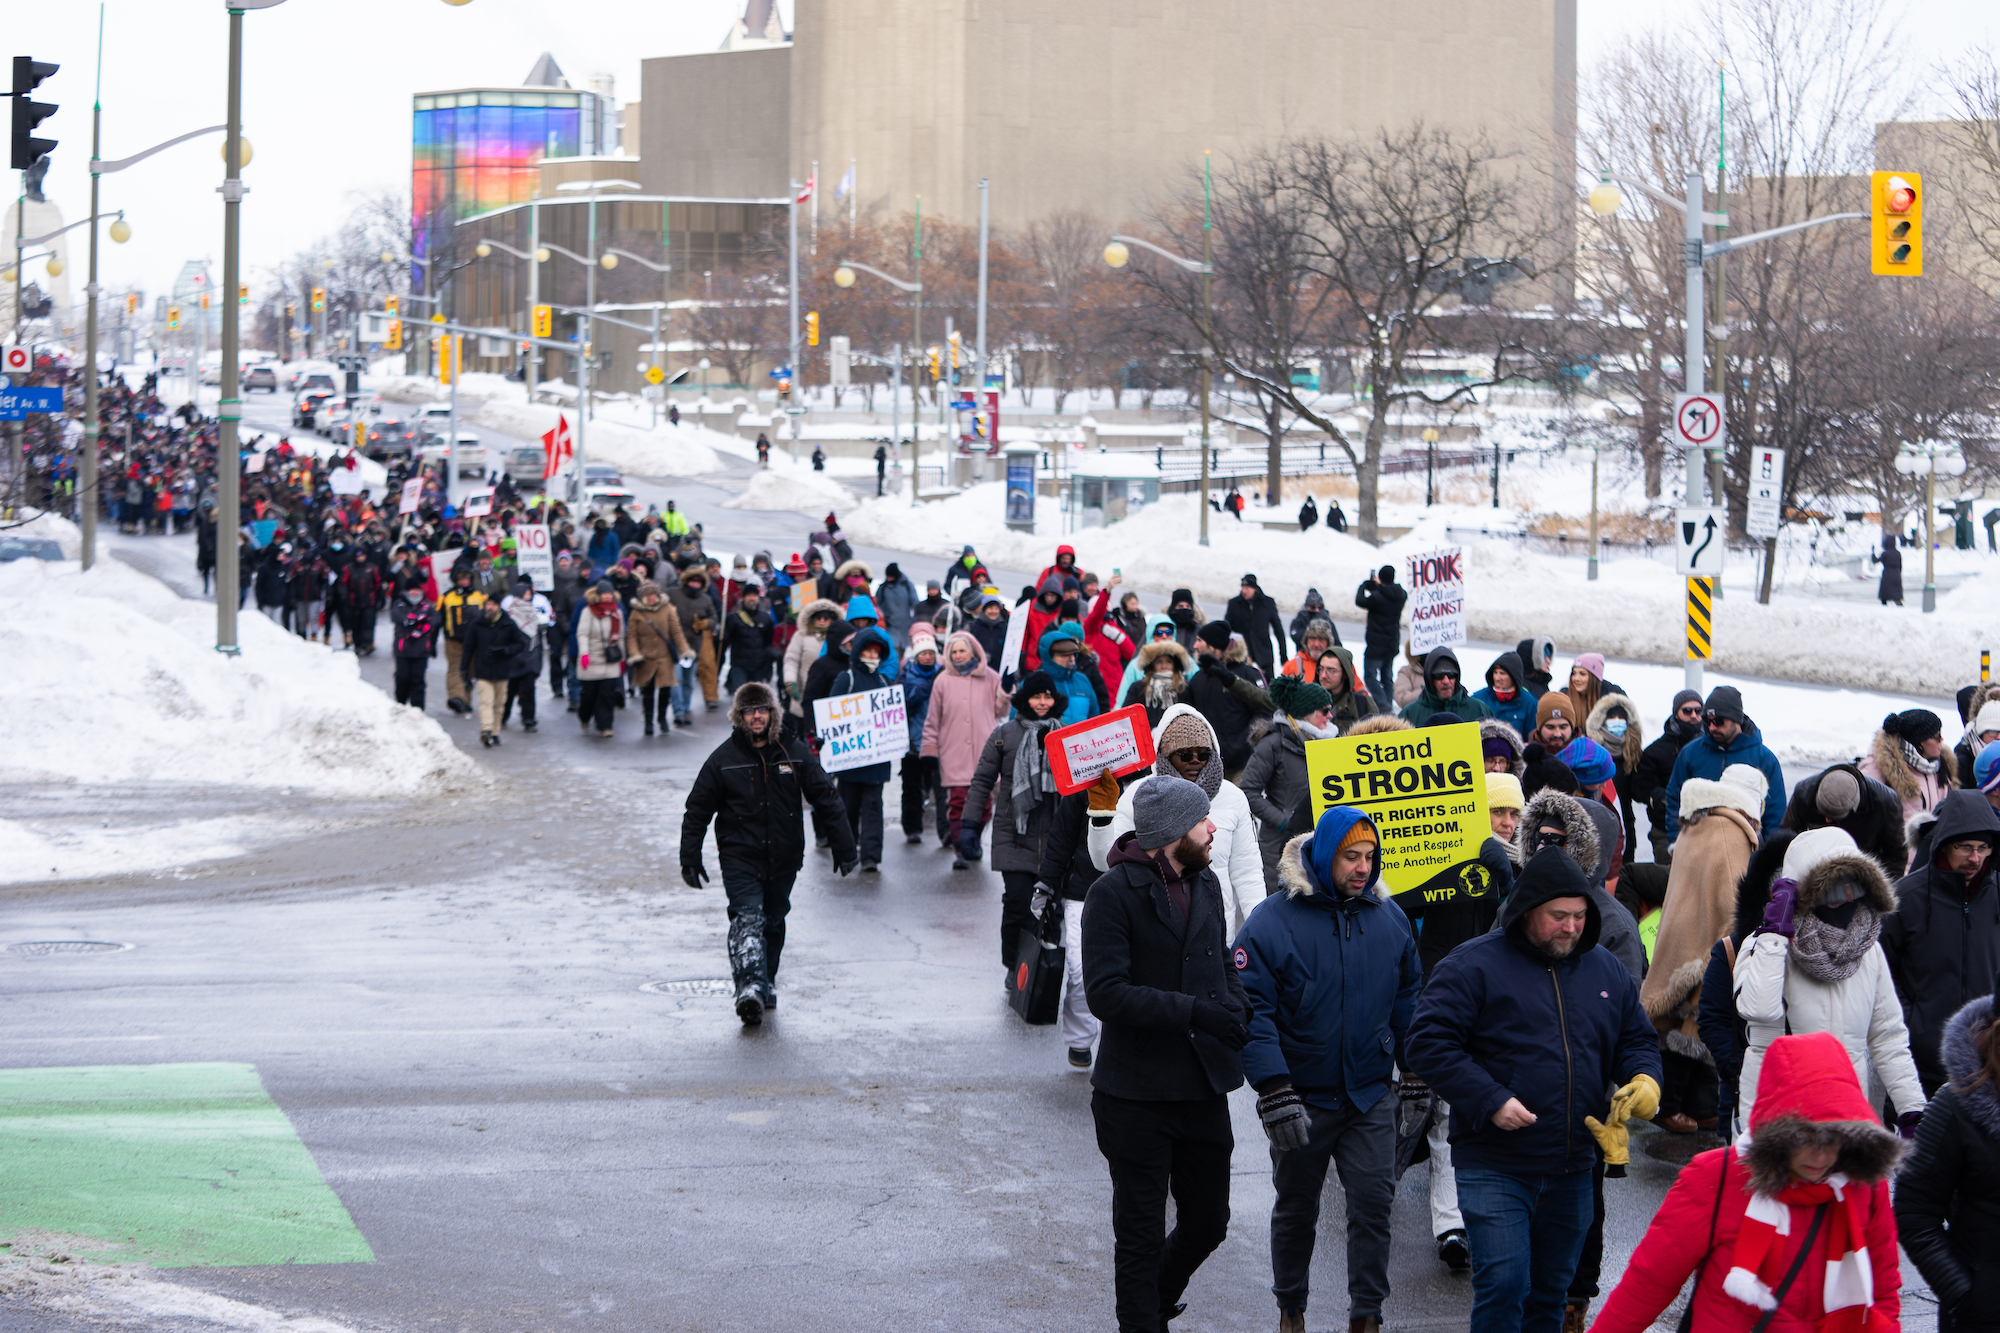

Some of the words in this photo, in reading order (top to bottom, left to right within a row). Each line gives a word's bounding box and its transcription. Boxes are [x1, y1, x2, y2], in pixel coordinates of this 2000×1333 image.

[0, 391, 18, 408] ier
[38, 399, 52, 409] W.
[519, 529, 546, 549] NO
[1412, 554, 1461, 588] HONK
[1416, 592, 1425, 605] if
[1444, 590, 1457, 599] are
[1412, 598, 1464, 622] AGAINST
[1414, 620, 1458, 635] Mandatory
[1413, 634, 1438, 649] Covid
[1441, 629, 1463, 644] Shots
[828, 695, 864, 720] LET
[870, 688, 902, 713] Kids
[821, 723, 852, 741] HAVE
[874, 707, 905, 728] LIVES
[831, 730, 872, 756] BACK!
[1097, 748, 1115, 758] gotta
[1356, 737, 1432, 765] Stand
[1322, 760, 1474, 801] STRONG
[1389, 805, 1446, 822] RIGHTS
[1450, 801, 1476, 815] and
[1382, 821, 1463, 840] FREEDOM,
[1381, 846, 1397, 856] ove
[1400, 842, 1420, 853] and
[1424, 837, 1464, 852] Respect
[1381, 860, 1400, 870] One
[1404, 853, 1451, 868] Another!
[1423, 888, 1457, 903] WTP
